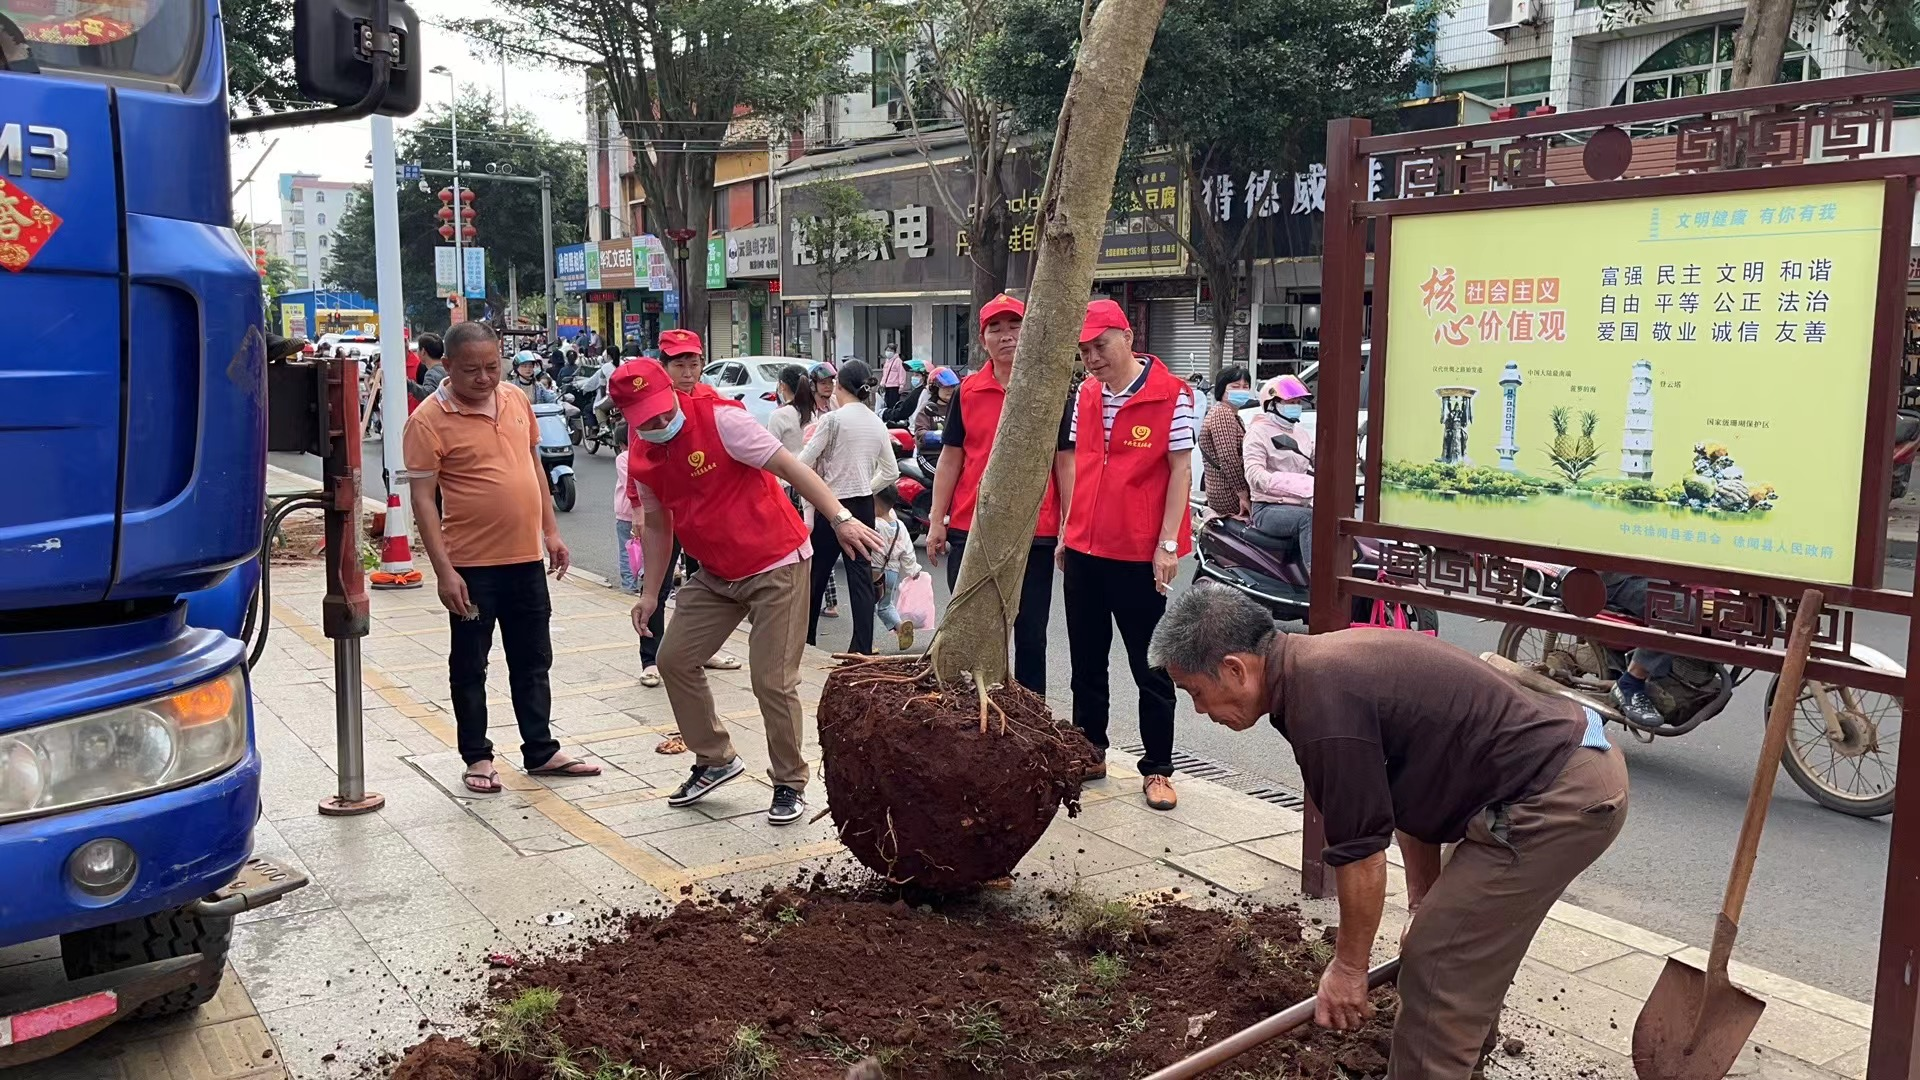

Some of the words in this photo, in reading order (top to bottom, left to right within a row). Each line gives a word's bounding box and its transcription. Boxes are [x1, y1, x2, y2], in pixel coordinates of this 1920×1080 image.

[1676, 208, 1748, 229] 文明健康
[1759, 203, 1837, 225] 有你有我
[1601, 266, 1643, 287] 富强
[1656, 263, 1701, 285] 民主
[1716, 261, 1764, 283] 文明
[1780, 258, 1832, 282] 和谐
[1466, 280, 1557, 302] 社会主义
[1600, 293, 1640, 314] 自由
[1655, 291, 1699, 314] 平等
[1713, 291, 1762, 313] 公正
[1777, 289, 1830, 313] 法治
[1478, 311, 1567, 341] 价值观
[1597, 321, 1639, 342] 爱国
[1652, 321, 1697, 342] 敬业
[1711, 320, 1760, 343] 诚信
[1775, 320, 1827, 343] 友善
[1570, 385, 1597, 393] 菠萝的海
[1660, 380, 1681, 388] 登云塔
[1706, 418, 1770, 429] 国家级珊瑚保护区
[1620, 522, 1721, 545] 中共徐闻县委员会
[1734, 536, 1834, 559] 徐闻县人民政府
